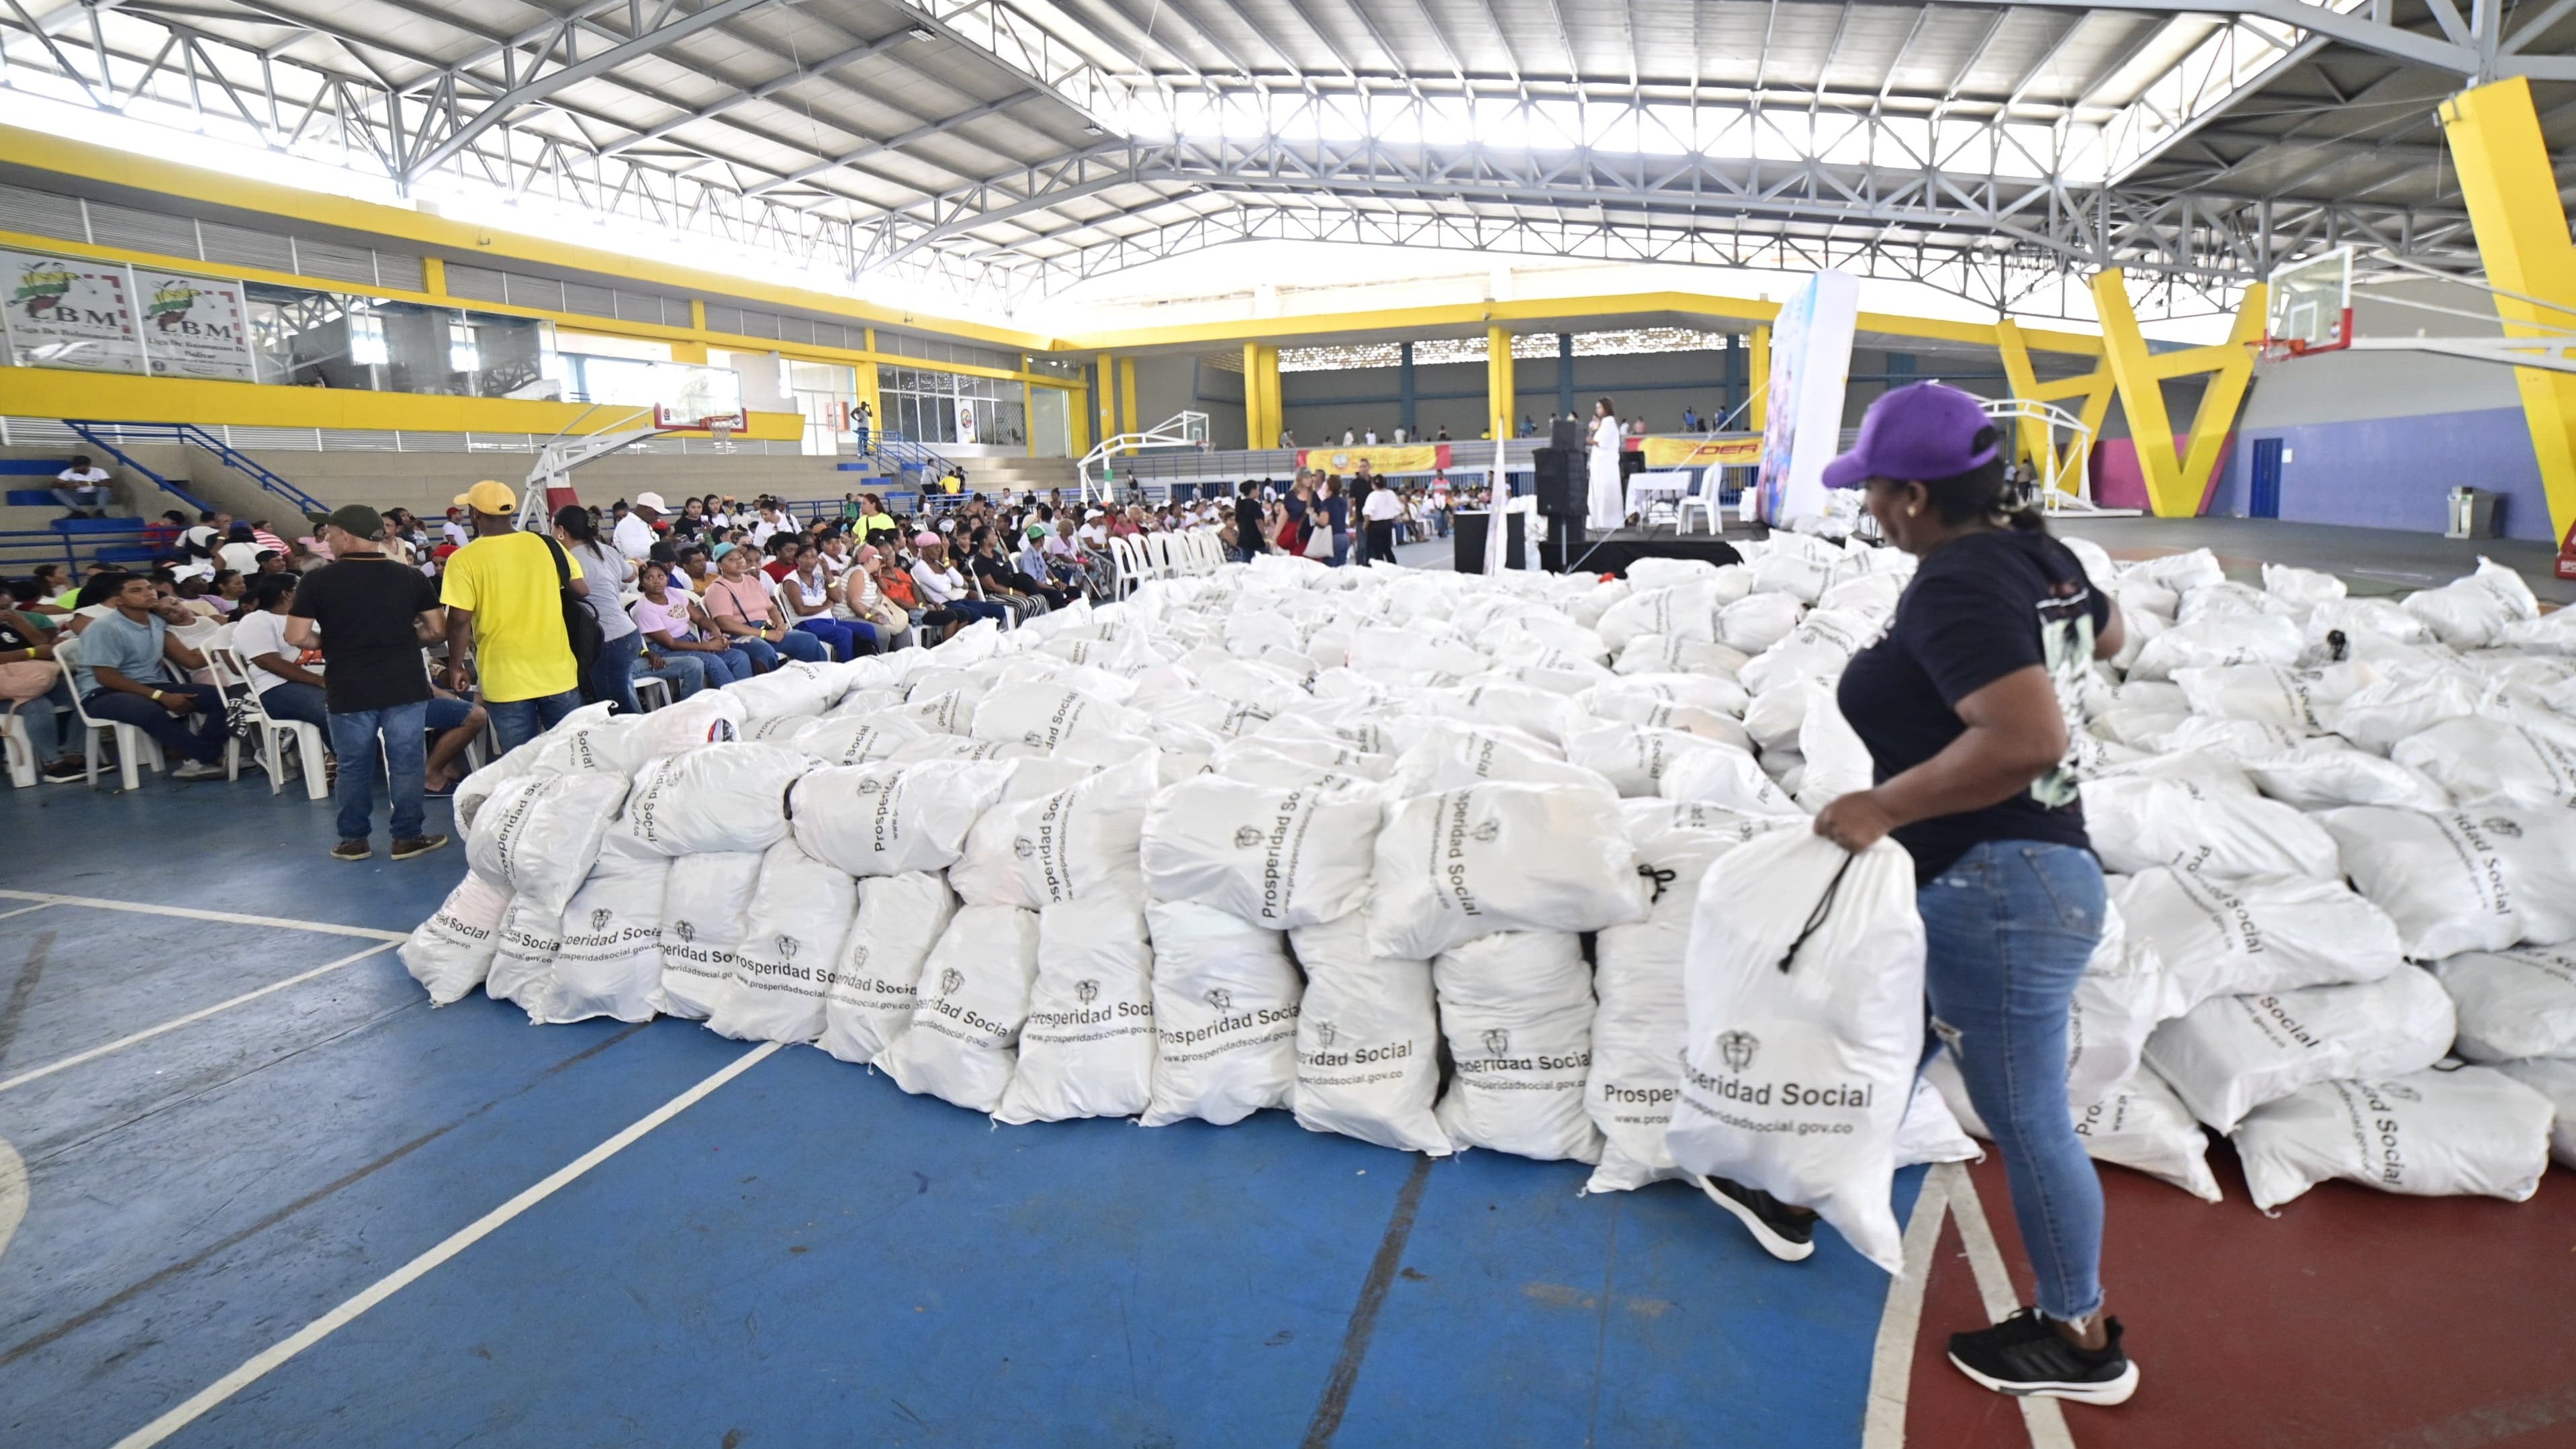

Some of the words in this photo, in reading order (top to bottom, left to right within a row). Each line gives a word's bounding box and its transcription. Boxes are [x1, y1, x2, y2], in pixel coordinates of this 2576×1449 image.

[1052, 692, 1079, 725] Social
[578, 731, 594, 769] Social
[845, 725, 870, 756] Social
[1477, 739, 1497, 778] ocial
[1262, 816, 1291, 919] Prosperidad
[1448, 864, 1481, 916] Social
[2483, 857, 2512, 915] Social
[449, 917, 490, 941] Social
[522, 934, 560, 952] Socia
[2225, 899, 2264, 954] Social
[736, 955, 811, 980] rosperidad
[876, 980, 917, 995] Socia
[964, 1011, 1014, 1037] Socia
[1118, 1002, 1154, 1017] Soci
[2260, 996, 2320, 1047] Social
[1160, 1013, 1252, 1050] Prosperidad
[1356, 1040, 1412, 1063] Social
[1781, 1082, 1872, 1108] Social
[2375, 1118, 2405, 1185] Social
